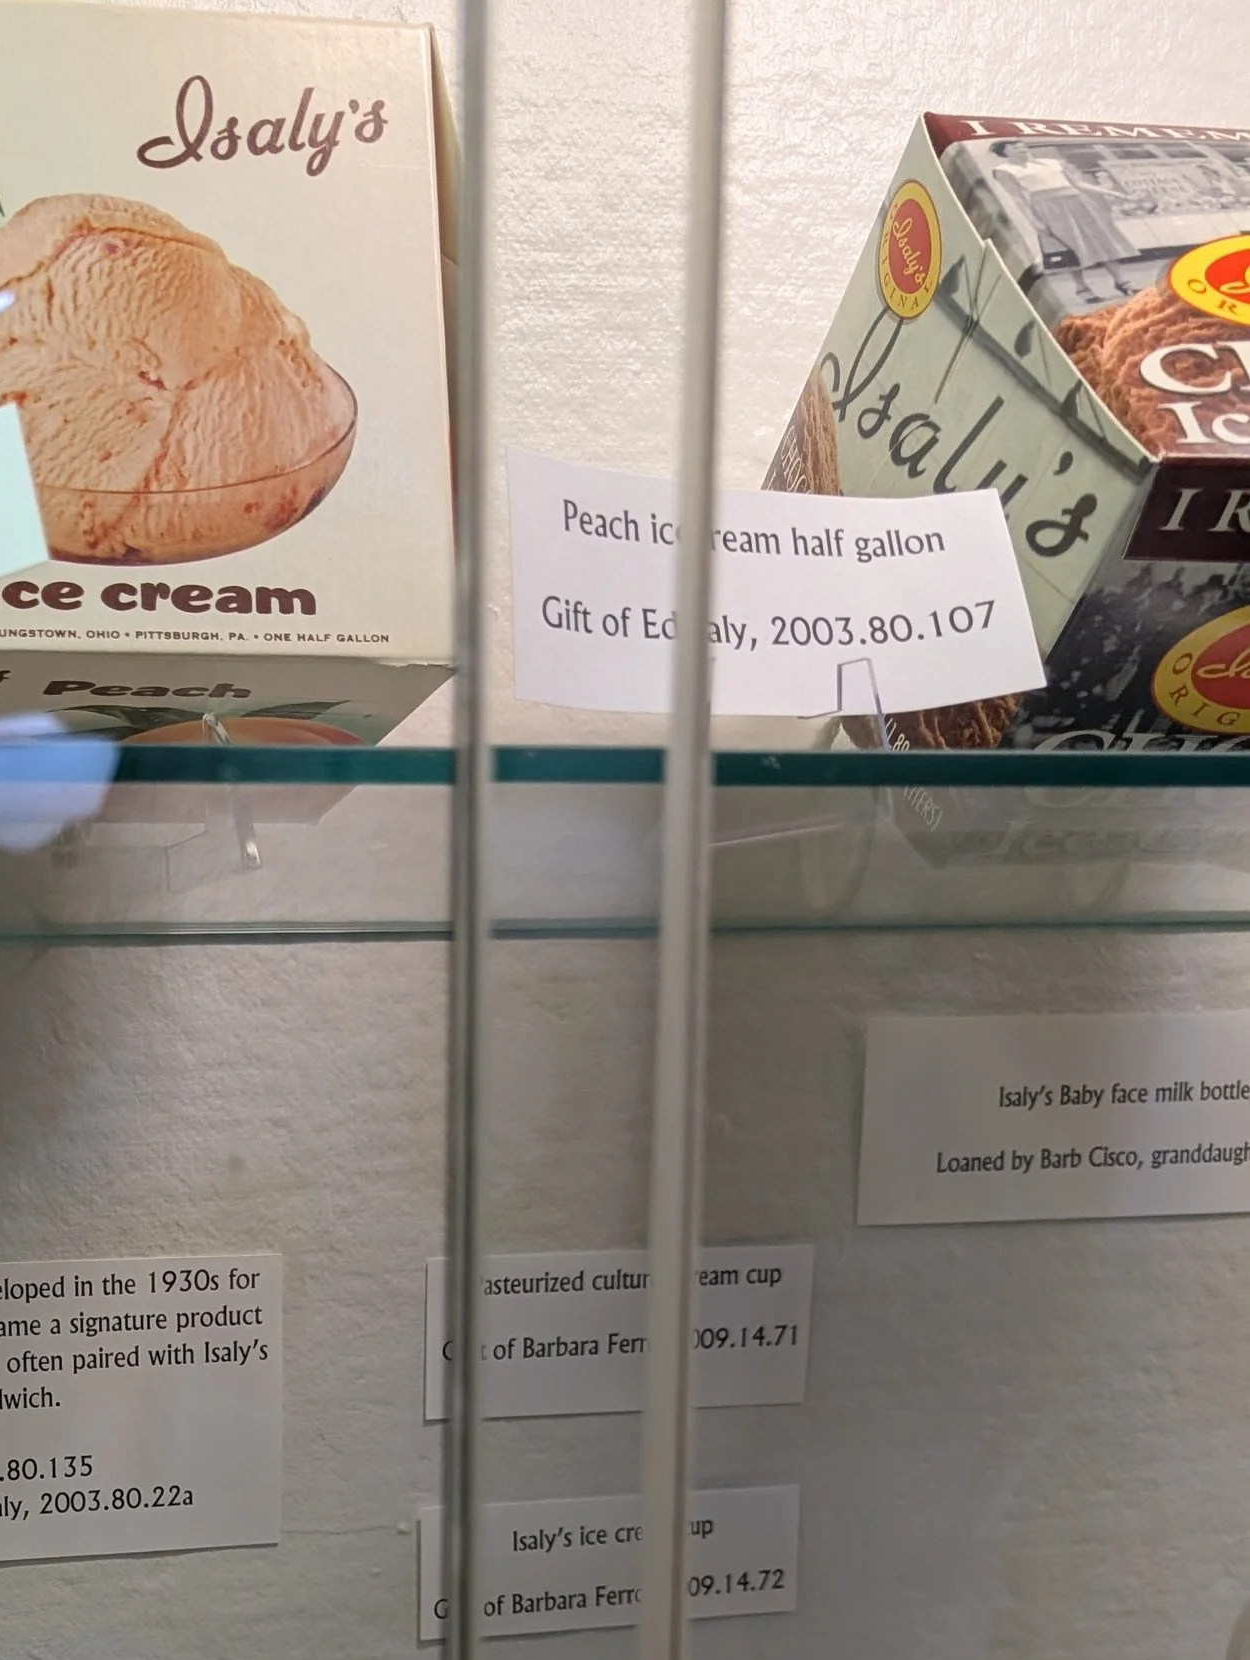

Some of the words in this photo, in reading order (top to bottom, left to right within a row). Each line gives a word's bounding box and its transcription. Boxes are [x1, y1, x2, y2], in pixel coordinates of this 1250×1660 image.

[137, 74, 388, 177] Isaly's
[892, 217, 928, 287] Isaly's
[563, 498, 640, 542] Peach
[711, 530, 782, 555] ream
[790, 526, 845, 557] half
[854, 529, 946, 564] gallon
[100, 580, 317, 616] cream
[541, 595, 593, 635] Gift
[601, 606, 632, 638] of
[770, 599, 995, 646] 2003.80.107
[85, 629, 121, 640] OHIO
[228, 632, 246, 641] PA.
[263, 632, 292, 642] ONE
[296, 633, 332, 643] HALF
[336, 633, 390, 643] GALLON
[43, 679, 252, 700] Peach
[999, 1084, 1054, 1112] Isaly's
[1059, 1083, 1105, 1109] Baby
[1111, 1082, 1149, 1105] face
[1154, 1081, 1194, 1103] milk
[936, 1150, 1005, 1174] Loaned
[1011, 1149, 1035, 1174] by
[1040, 1147, 1082, 1170] Barb
[1088, 1145, 1144, 1170] Cisco,
[74, 1274, 94, 1297] in
[101, 1273, 136, 1296] the
[149, 1268, 219, 1294] 1930s
[228, 1267, 261, 1290] for
[484, 1269, 585, 1296] asteurized
[745, 1267, 783, 1288] cup
[49, 1318, 61, 1335] a
[69, 1311, 167, 1338] signature
[176, 1304, 263, 1333] product
[492, 1337, 517, 1361] of
[522, 1335, 599, 1359] Barbara
[512, 1526, 573, 1554] Isaly's
[579, 1525, 608, 1546] ice
[483, 1594, 506, 1617] of
[512, 1591, 587, 1615] Barbara
